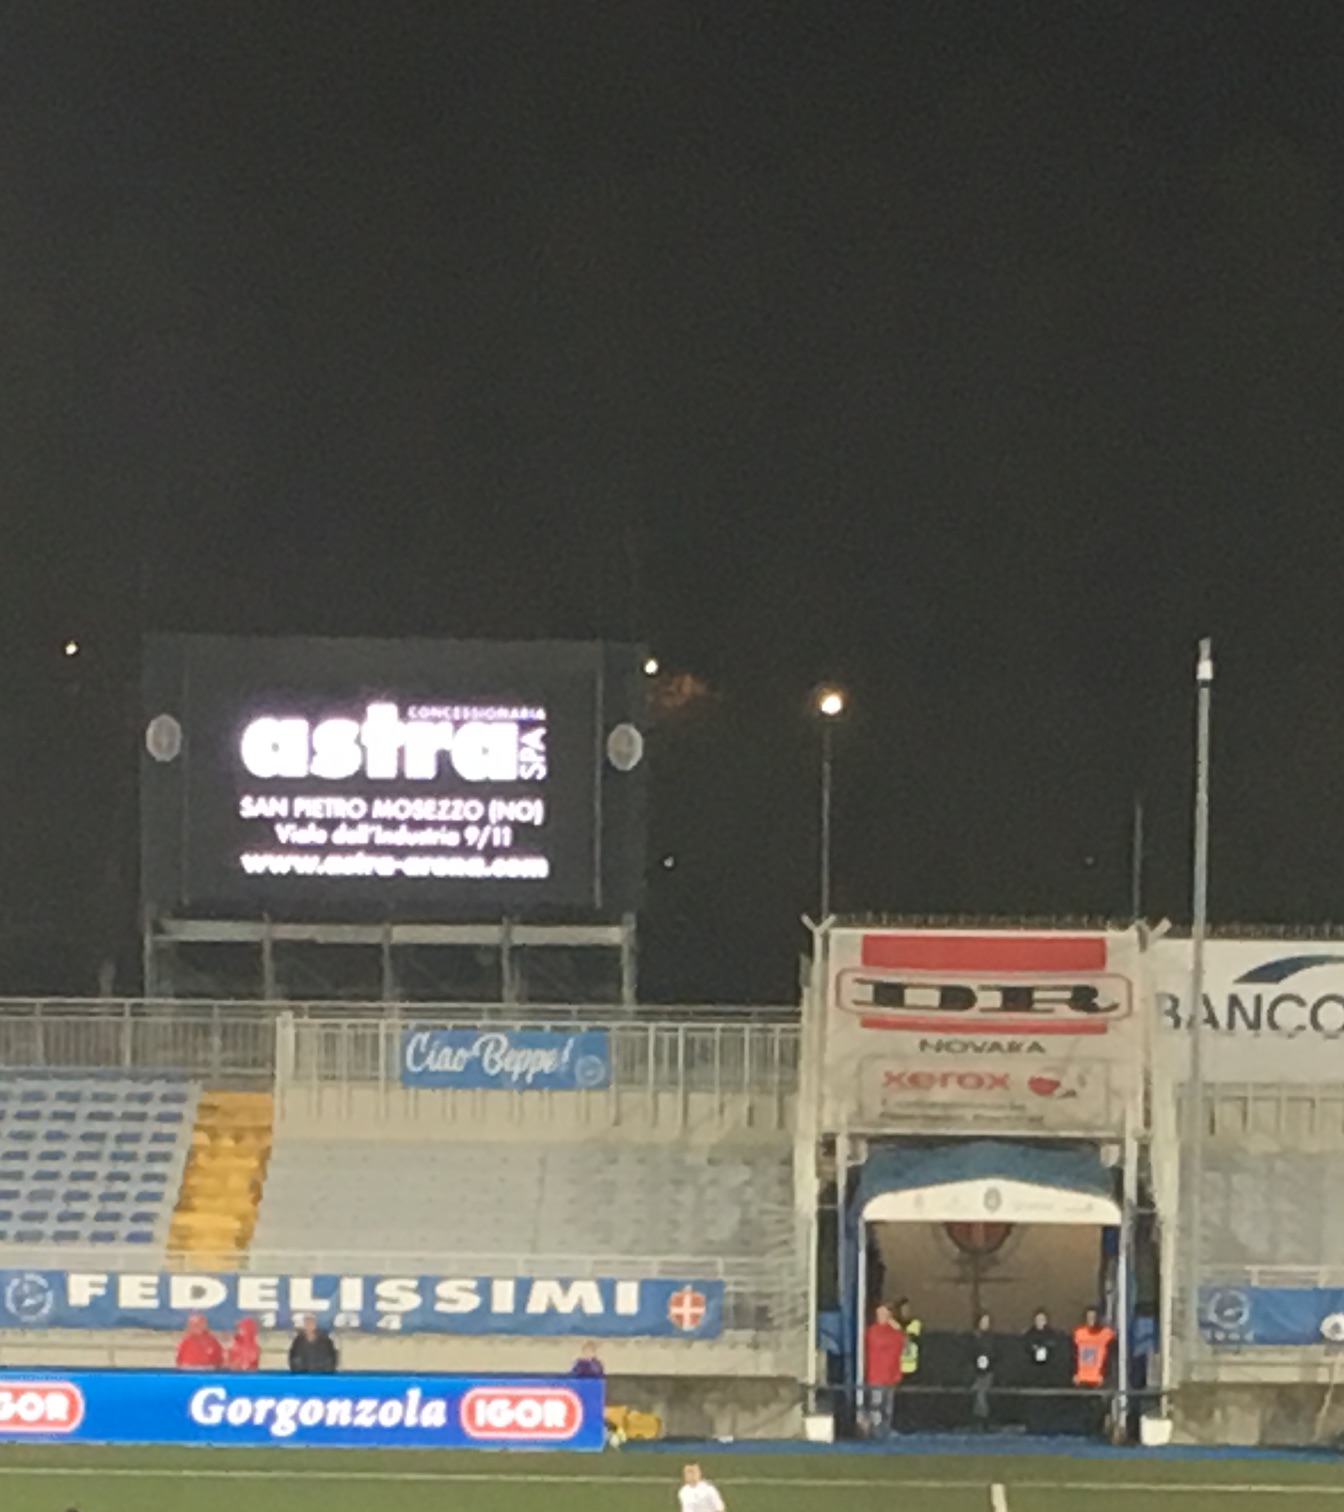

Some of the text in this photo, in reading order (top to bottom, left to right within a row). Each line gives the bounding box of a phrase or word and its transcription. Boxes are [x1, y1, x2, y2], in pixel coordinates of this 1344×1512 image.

[241, 701, 520, 782] astra
[240, 796, 544, 825] SAN PIETRO MOSEZZO (NO)
[464, 824, 512, 850] 9/11
[407, 1031, 469, 1072] Ciao
[919, 1038, 1046, 1054] NOVARA
[883, 1070, 1010, 1090] xerox
[67, 1273, 641, 1317] FEDELISSIMI
[190, 1387, 567, 1437] Gorgonzola IGOR
